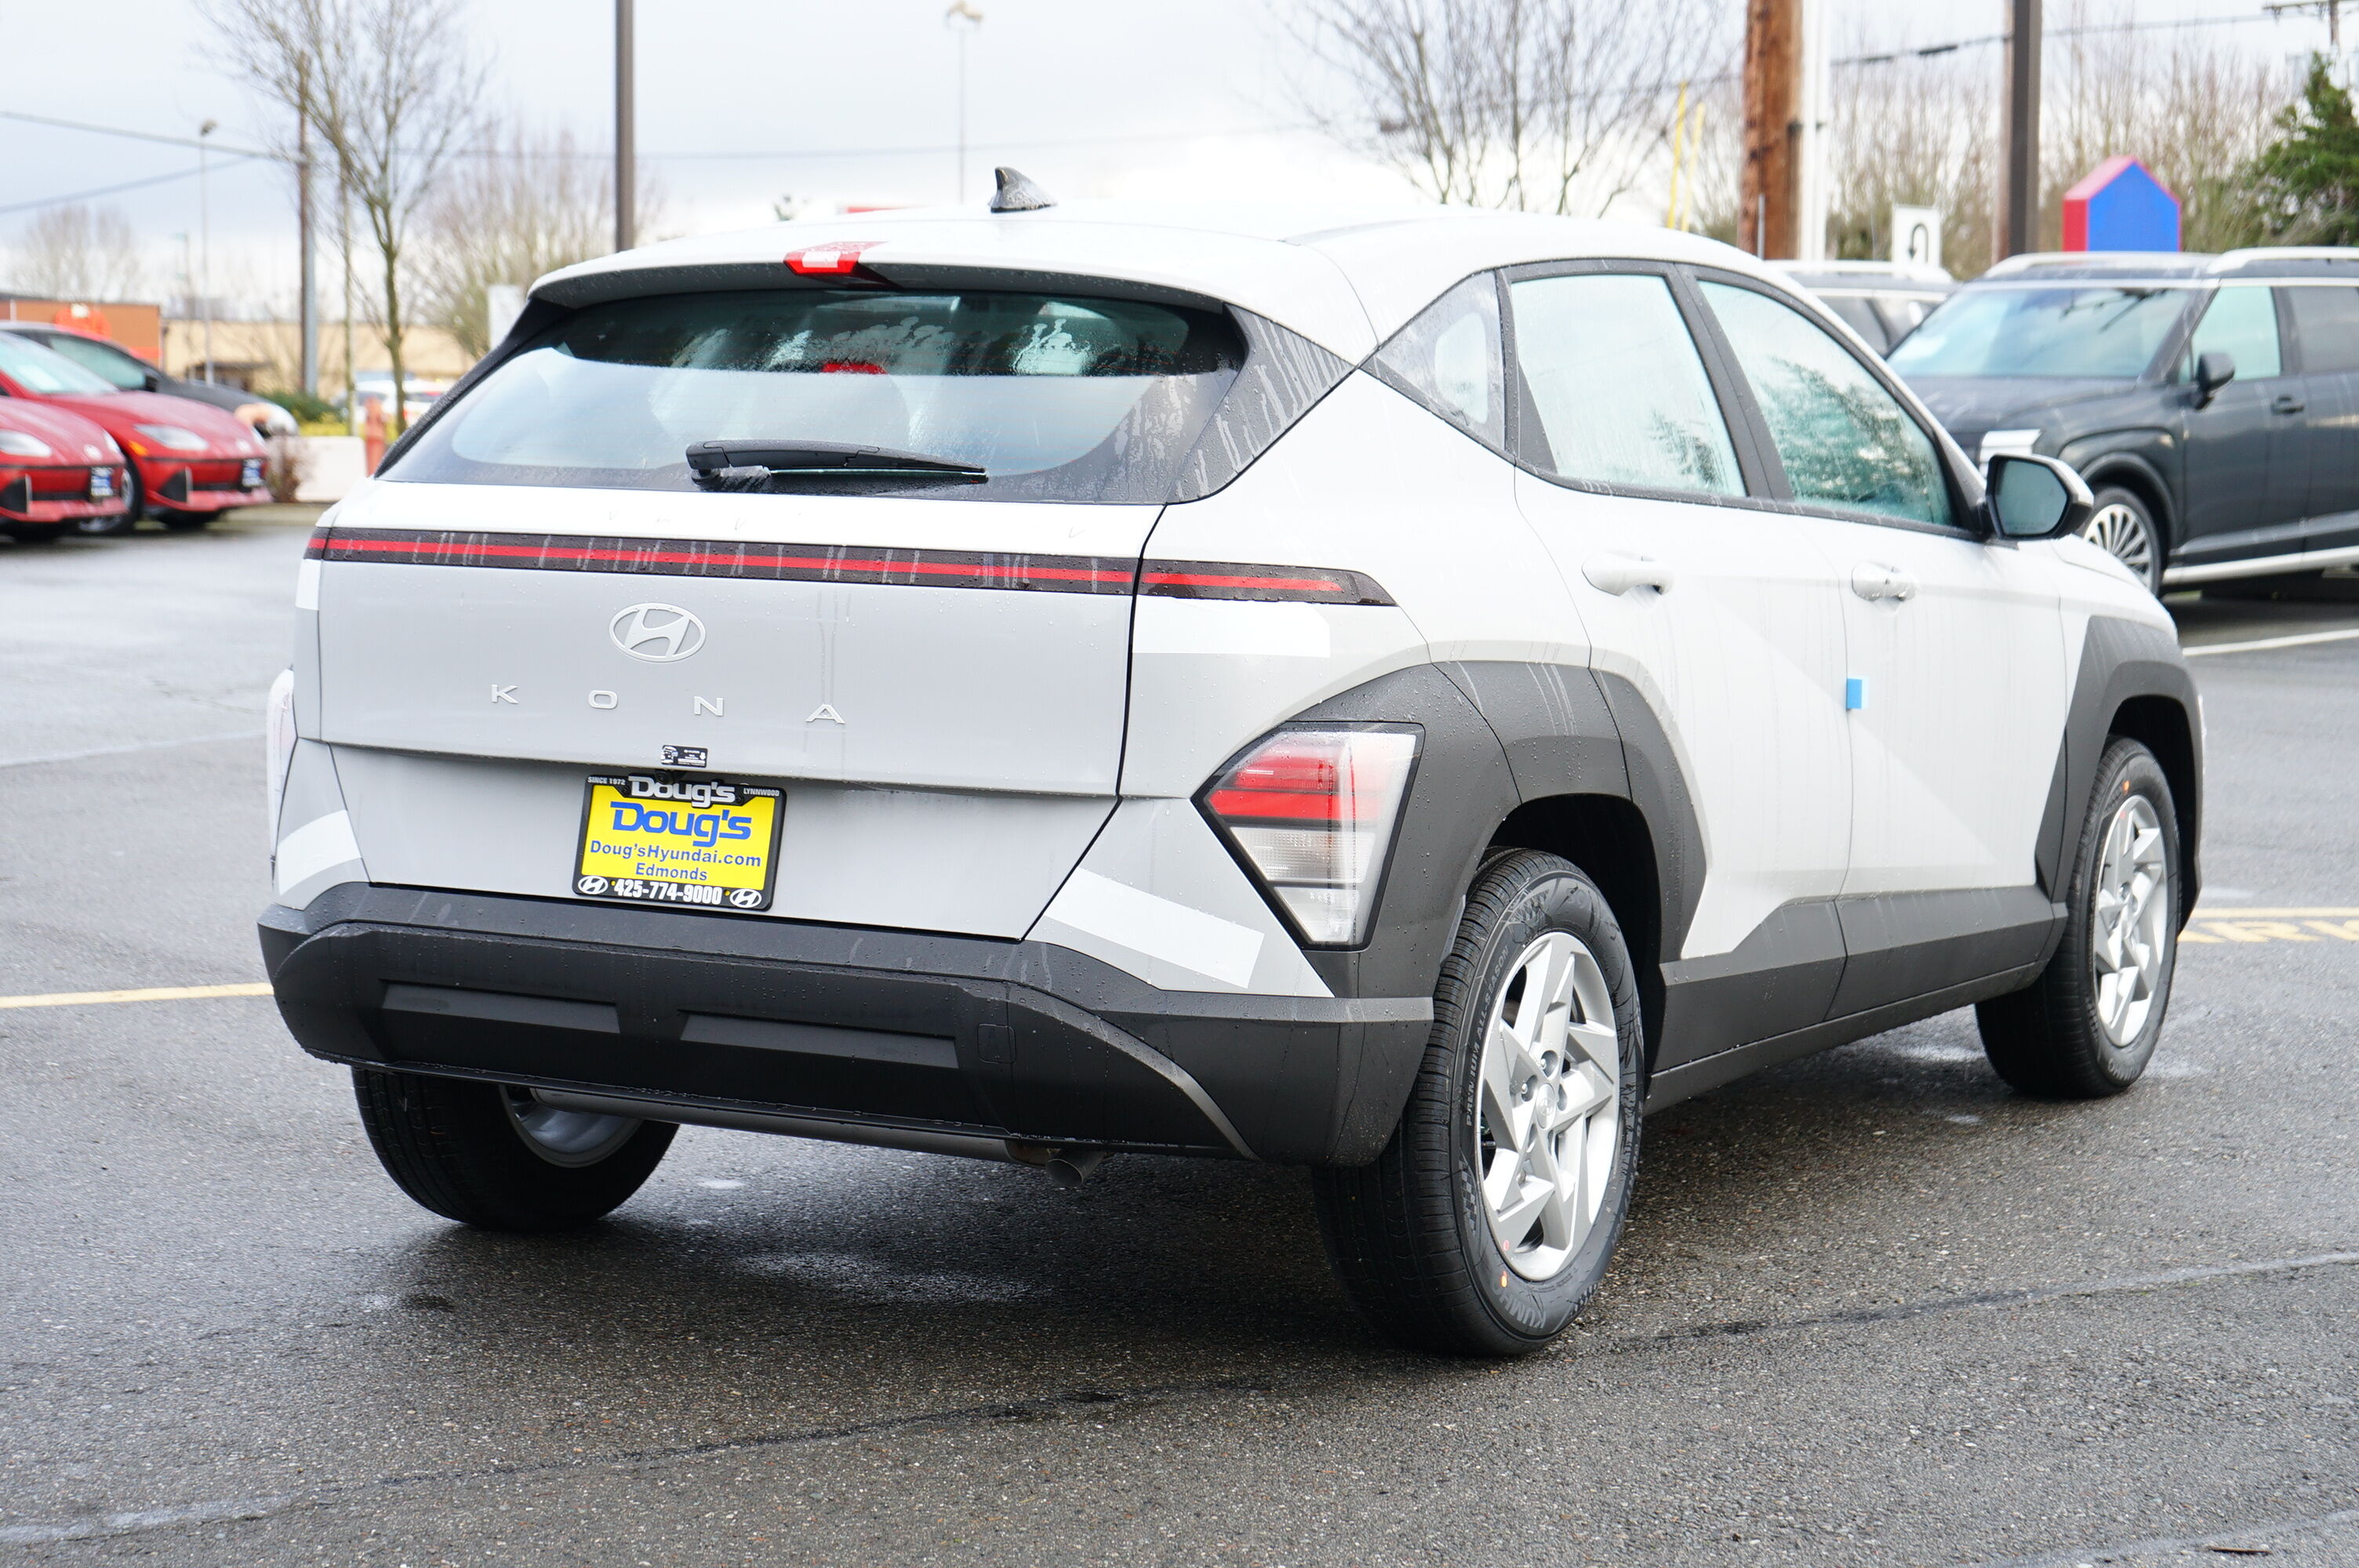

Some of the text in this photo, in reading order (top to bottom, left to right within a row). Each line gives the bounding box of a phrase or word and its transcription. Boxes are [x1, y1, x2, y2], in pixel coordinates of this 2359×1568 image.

[490, 684, 846, 724] KONA
[587, 775, 609, 785] SINCE
[628, 775, 736, 808] Doug's
[743, 787, 780, 797] LYNNWOOD
[610, 801, 752, 848] Doug's
[590, 840, 761, 867] Doug'sHyundai.com
[635, 862, 708, 881] Edmonds
[613, 878, 722, 905] 425-774-9000
